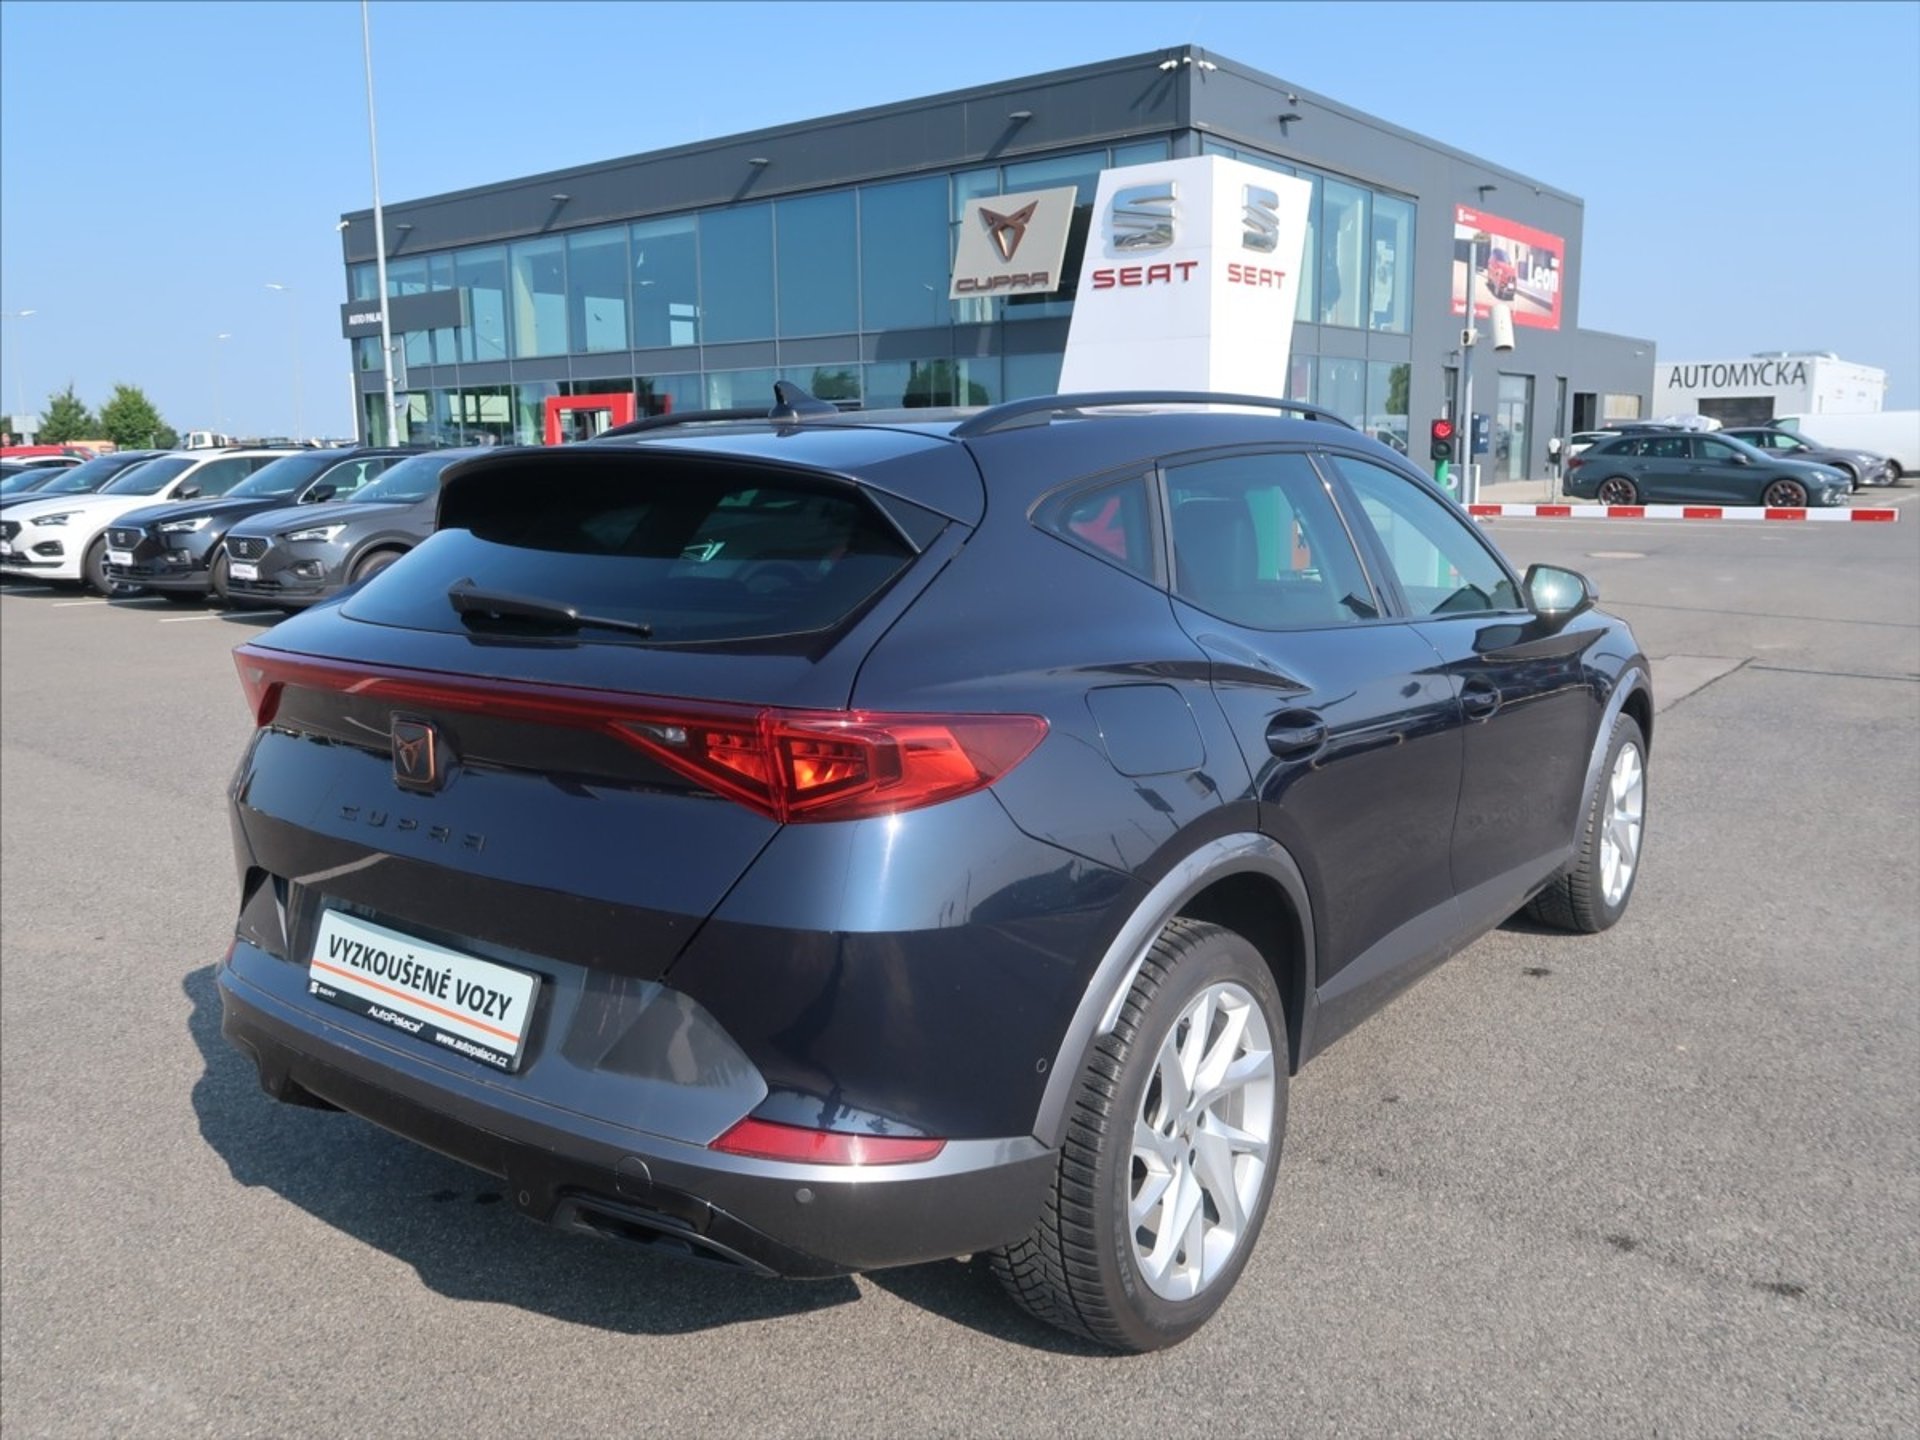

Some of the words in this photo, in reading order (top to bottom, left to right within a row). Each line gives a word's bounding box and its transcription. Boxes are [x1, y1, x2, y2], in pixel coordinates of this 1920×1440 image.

[955, 271, 1050, 293] CUPRA
[1092, 261, 1198, 289] SEAT
[1227, 263, 1286, 289] SEAT
[1668, 360, 1806, 388] AUTOMYČKA
[329, 934, 452, 1000] VYZKOUŠENÉ
[456, 978, 512, 1021] VOZY
[367, 1005, 421, 1033] AutoPalace
[435, 1032, 508, 1068] www.autopalace.cz
